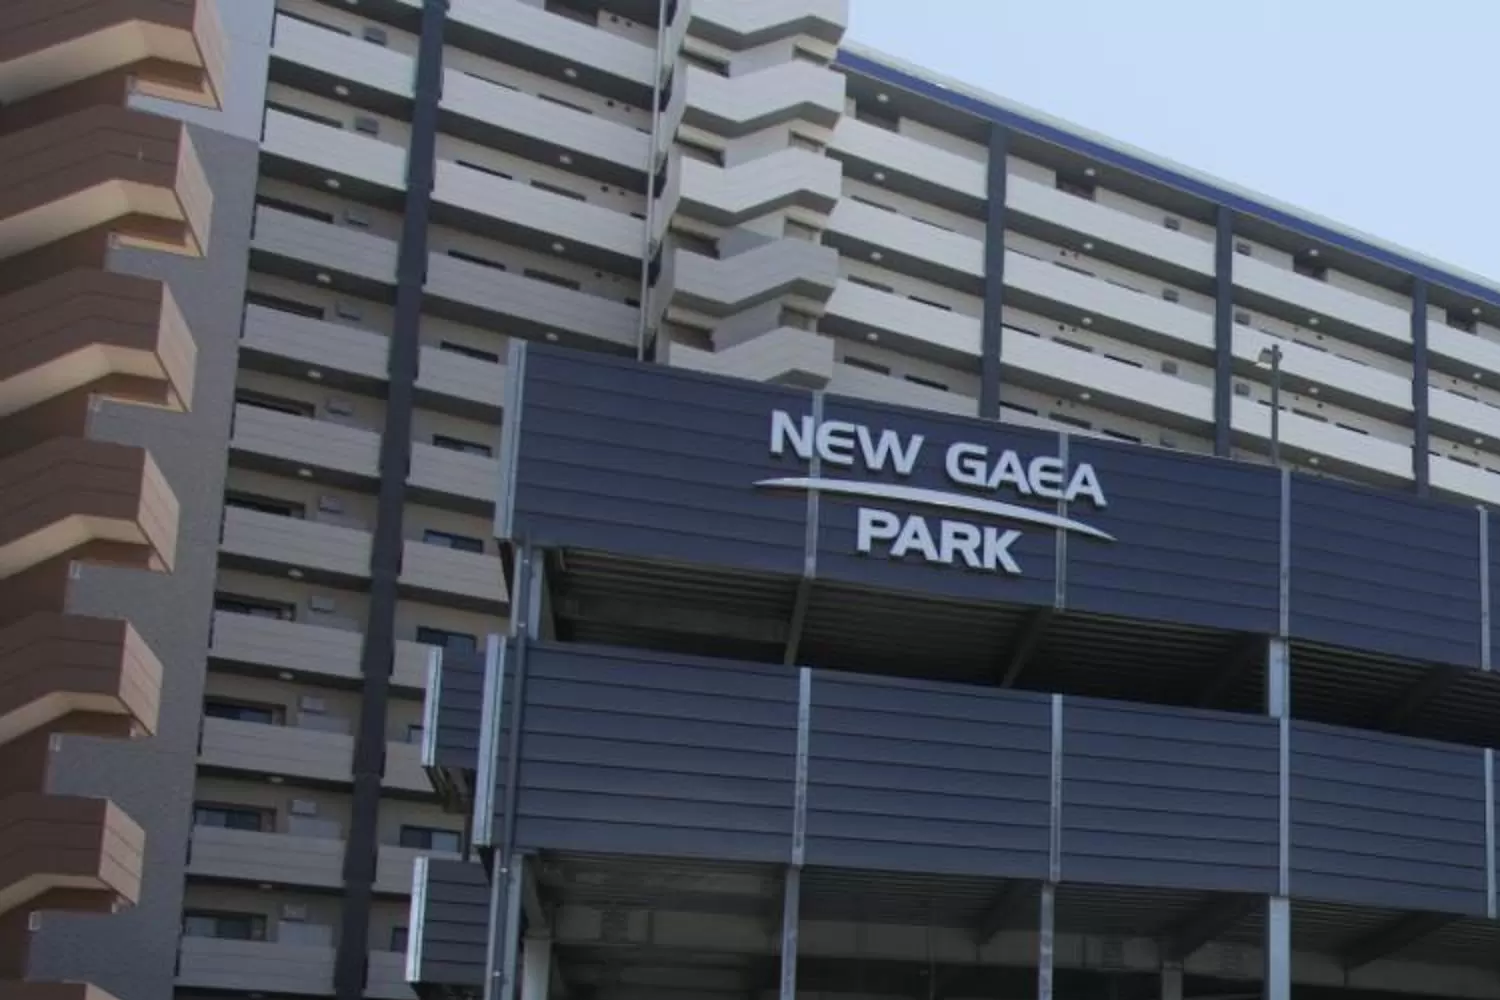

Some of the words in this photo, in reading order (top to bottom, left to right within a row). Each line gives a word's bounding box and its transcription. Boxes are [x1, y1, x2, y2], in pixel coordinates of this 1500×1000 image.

[770, 410, 925, 474] NEW
[945, 442, 1108, 506] GAEA
[857, 507, 1023, 574] PARK
